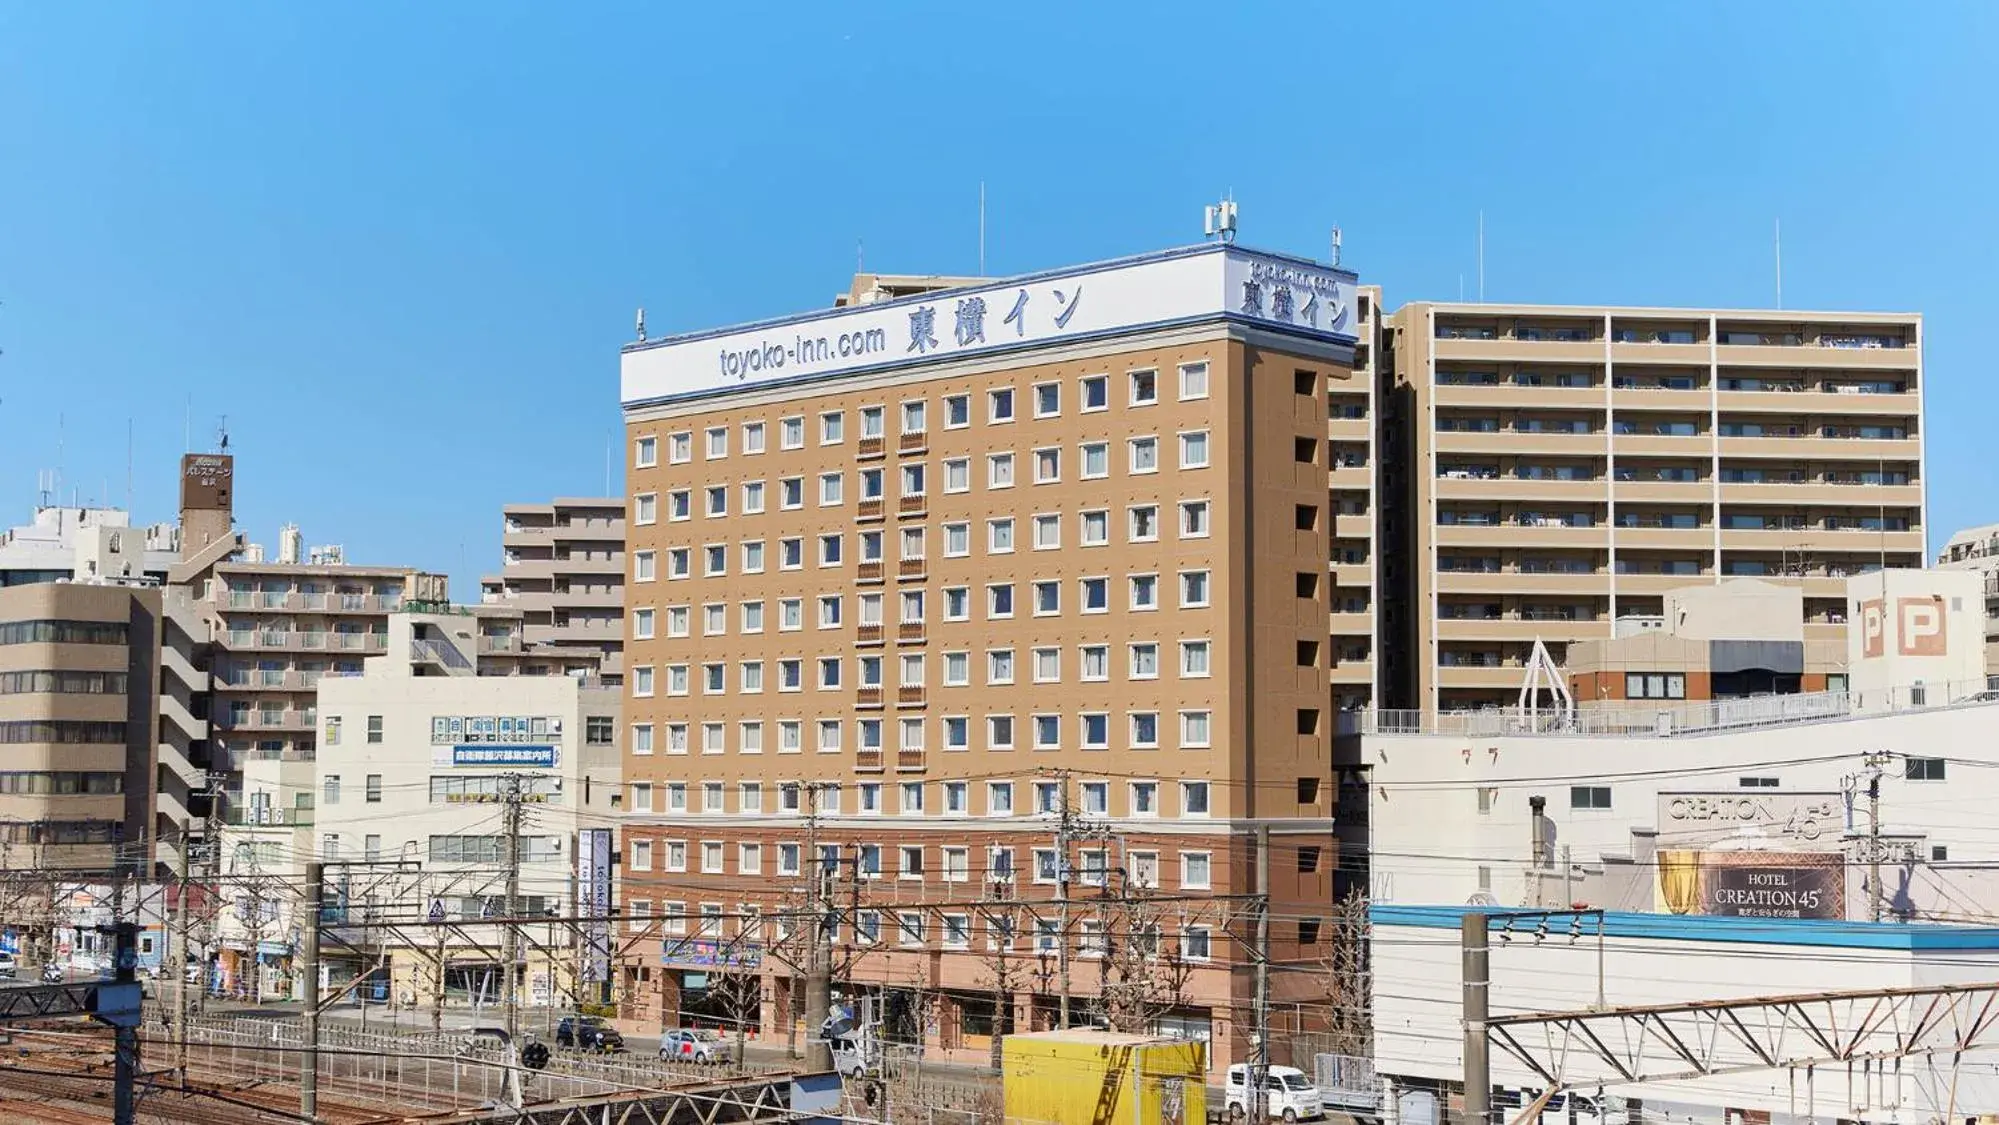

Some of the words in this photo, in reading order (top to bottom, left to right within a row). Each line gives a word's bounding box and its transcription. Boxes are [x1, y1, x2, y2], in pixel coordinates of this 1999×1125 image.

[907, 284, 1082, 353] 東横イン
[1240, 280, 1347, 327] 東横イン
[720, 326, 886, 380] toyoko-inn.com
[1864, 607, 1881, 652] P
[1904, 605, 1940, 649] P
[1669, 797, 1776, 820] CREATION
[1715, 888, 1797, 906] CREATION
[1748, 874, 1788, 885] HOTEL
